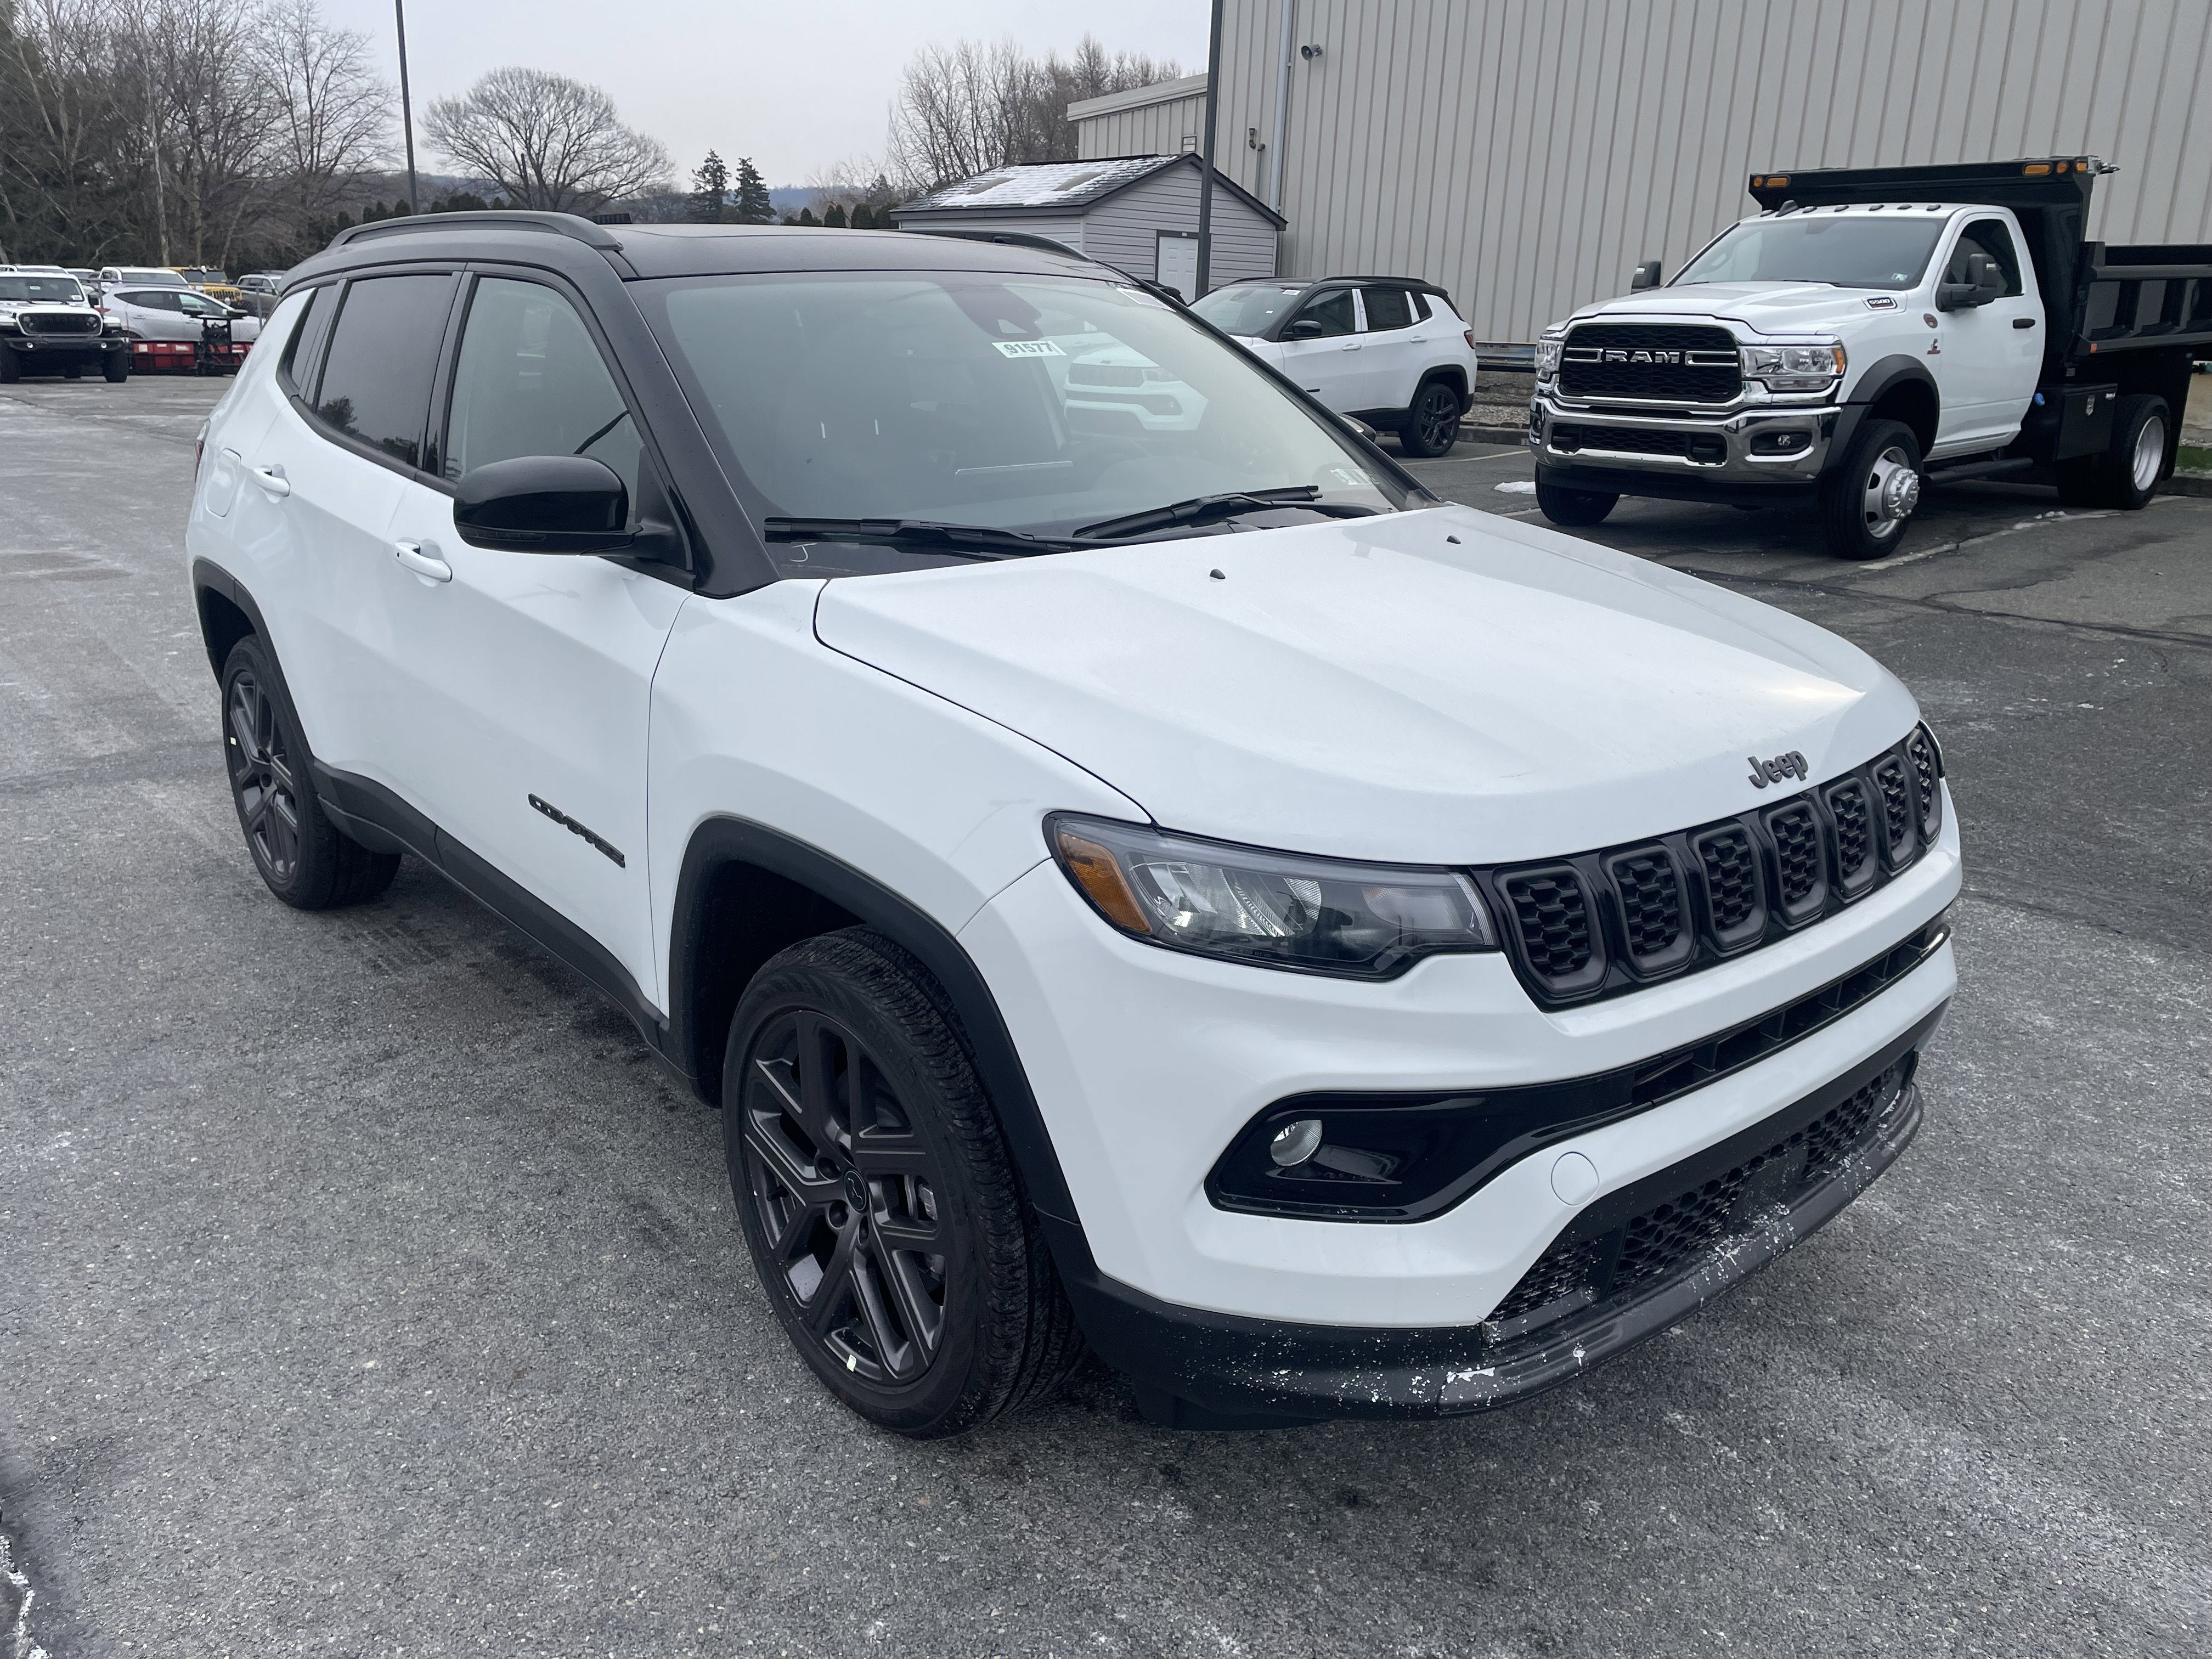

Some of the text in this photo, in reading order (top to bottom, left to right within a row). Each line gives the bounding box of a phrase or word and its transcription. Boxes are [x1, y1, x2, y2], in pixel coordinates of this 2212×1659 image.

[1003, 343, 1053, 353] 91577
[1605, 351, 1680, 363] RAM
[1748, 751, 1809, 789] Jeep
